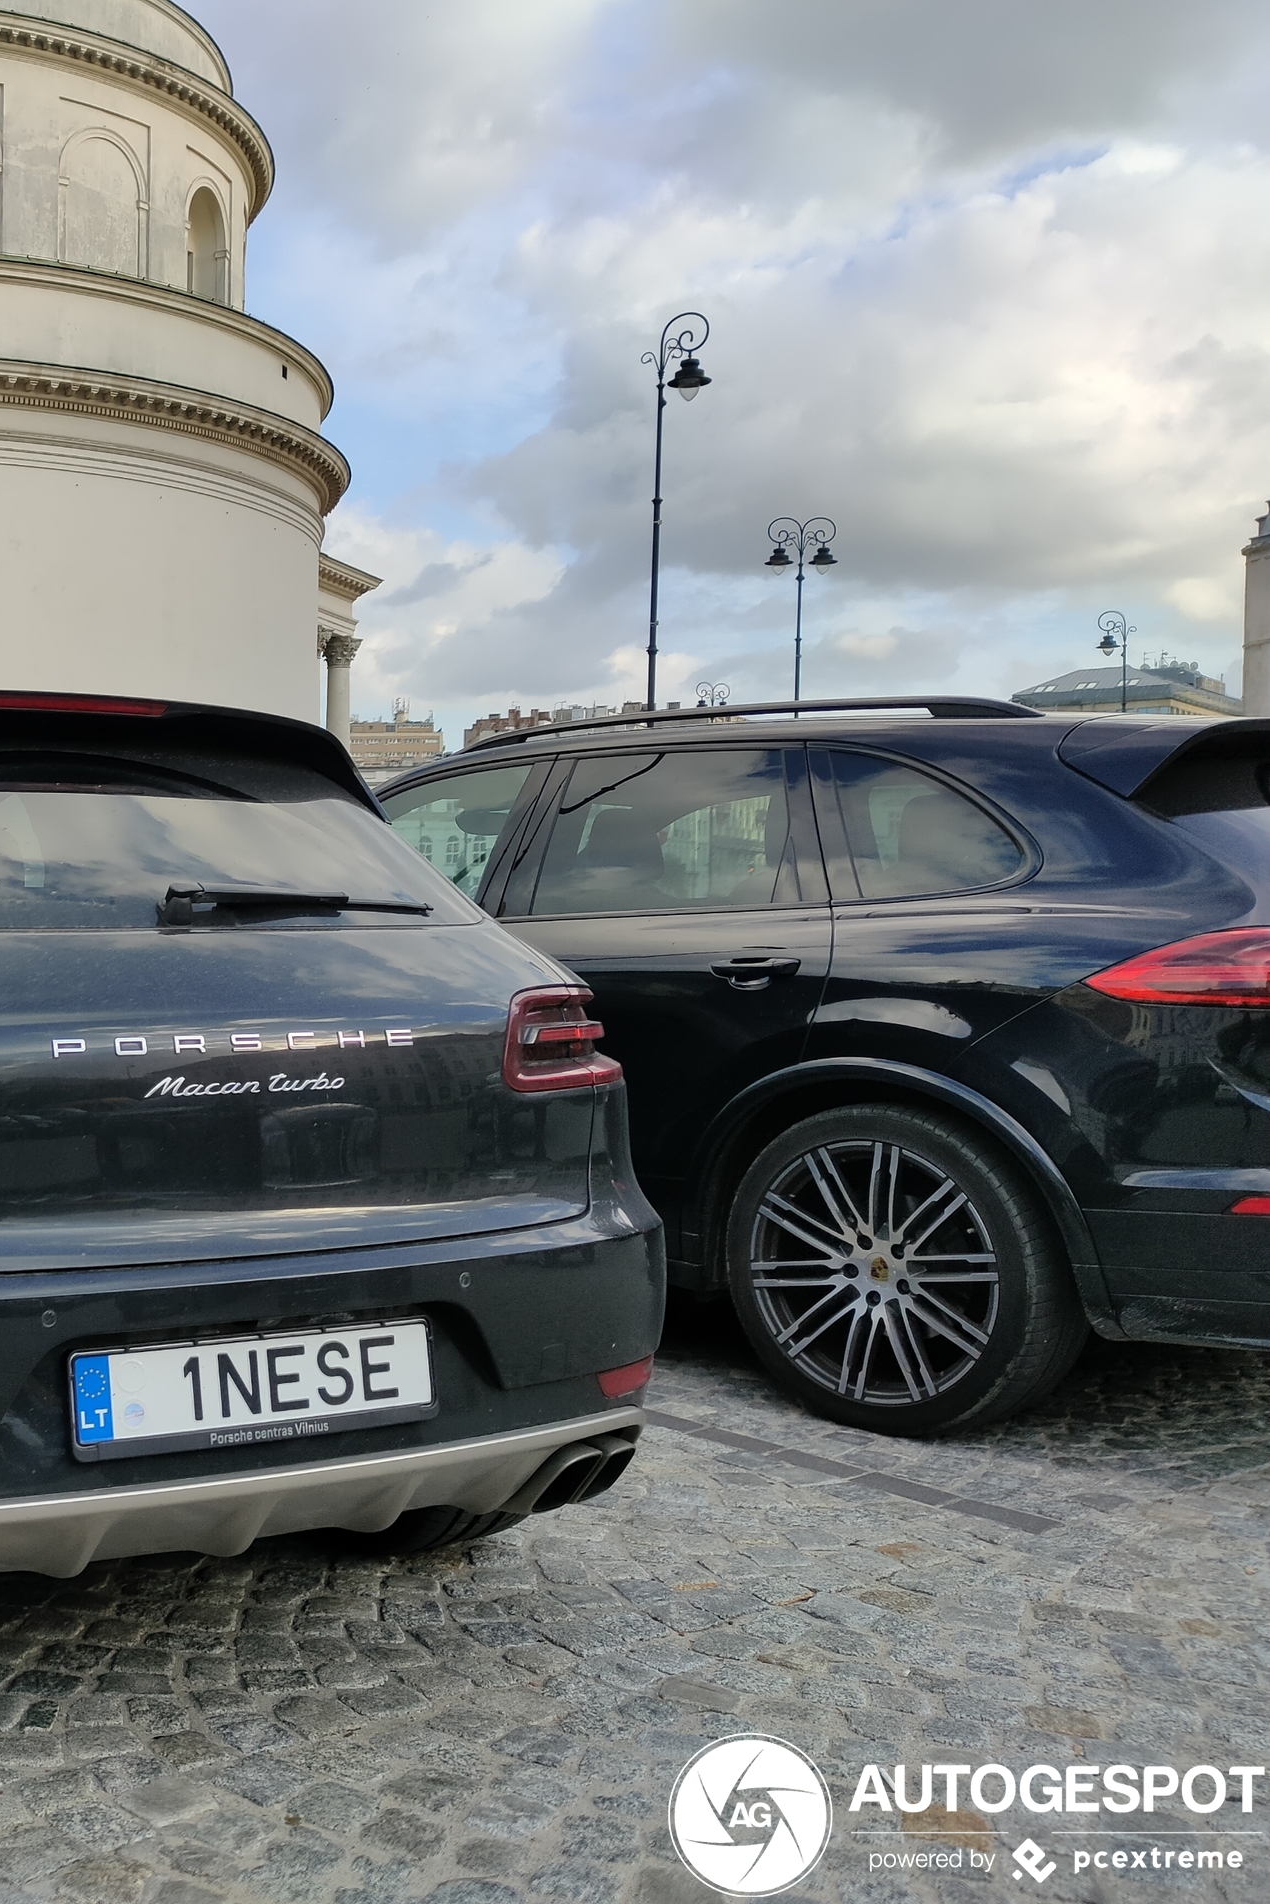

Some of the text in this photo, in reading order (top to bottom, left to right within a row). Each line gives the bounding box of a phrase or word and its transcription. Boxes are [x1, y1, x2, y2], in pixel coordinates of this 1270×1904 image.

[51, 1028, 414, 1058] PORSCHE
[143, 1075, 261, 1099] Macan
[182, 1334, 399, 1421] 1NESE
[80, 1408, 109, 1429] LT
[210, 1420, 329, 1445] Porsche centras Vilnius
